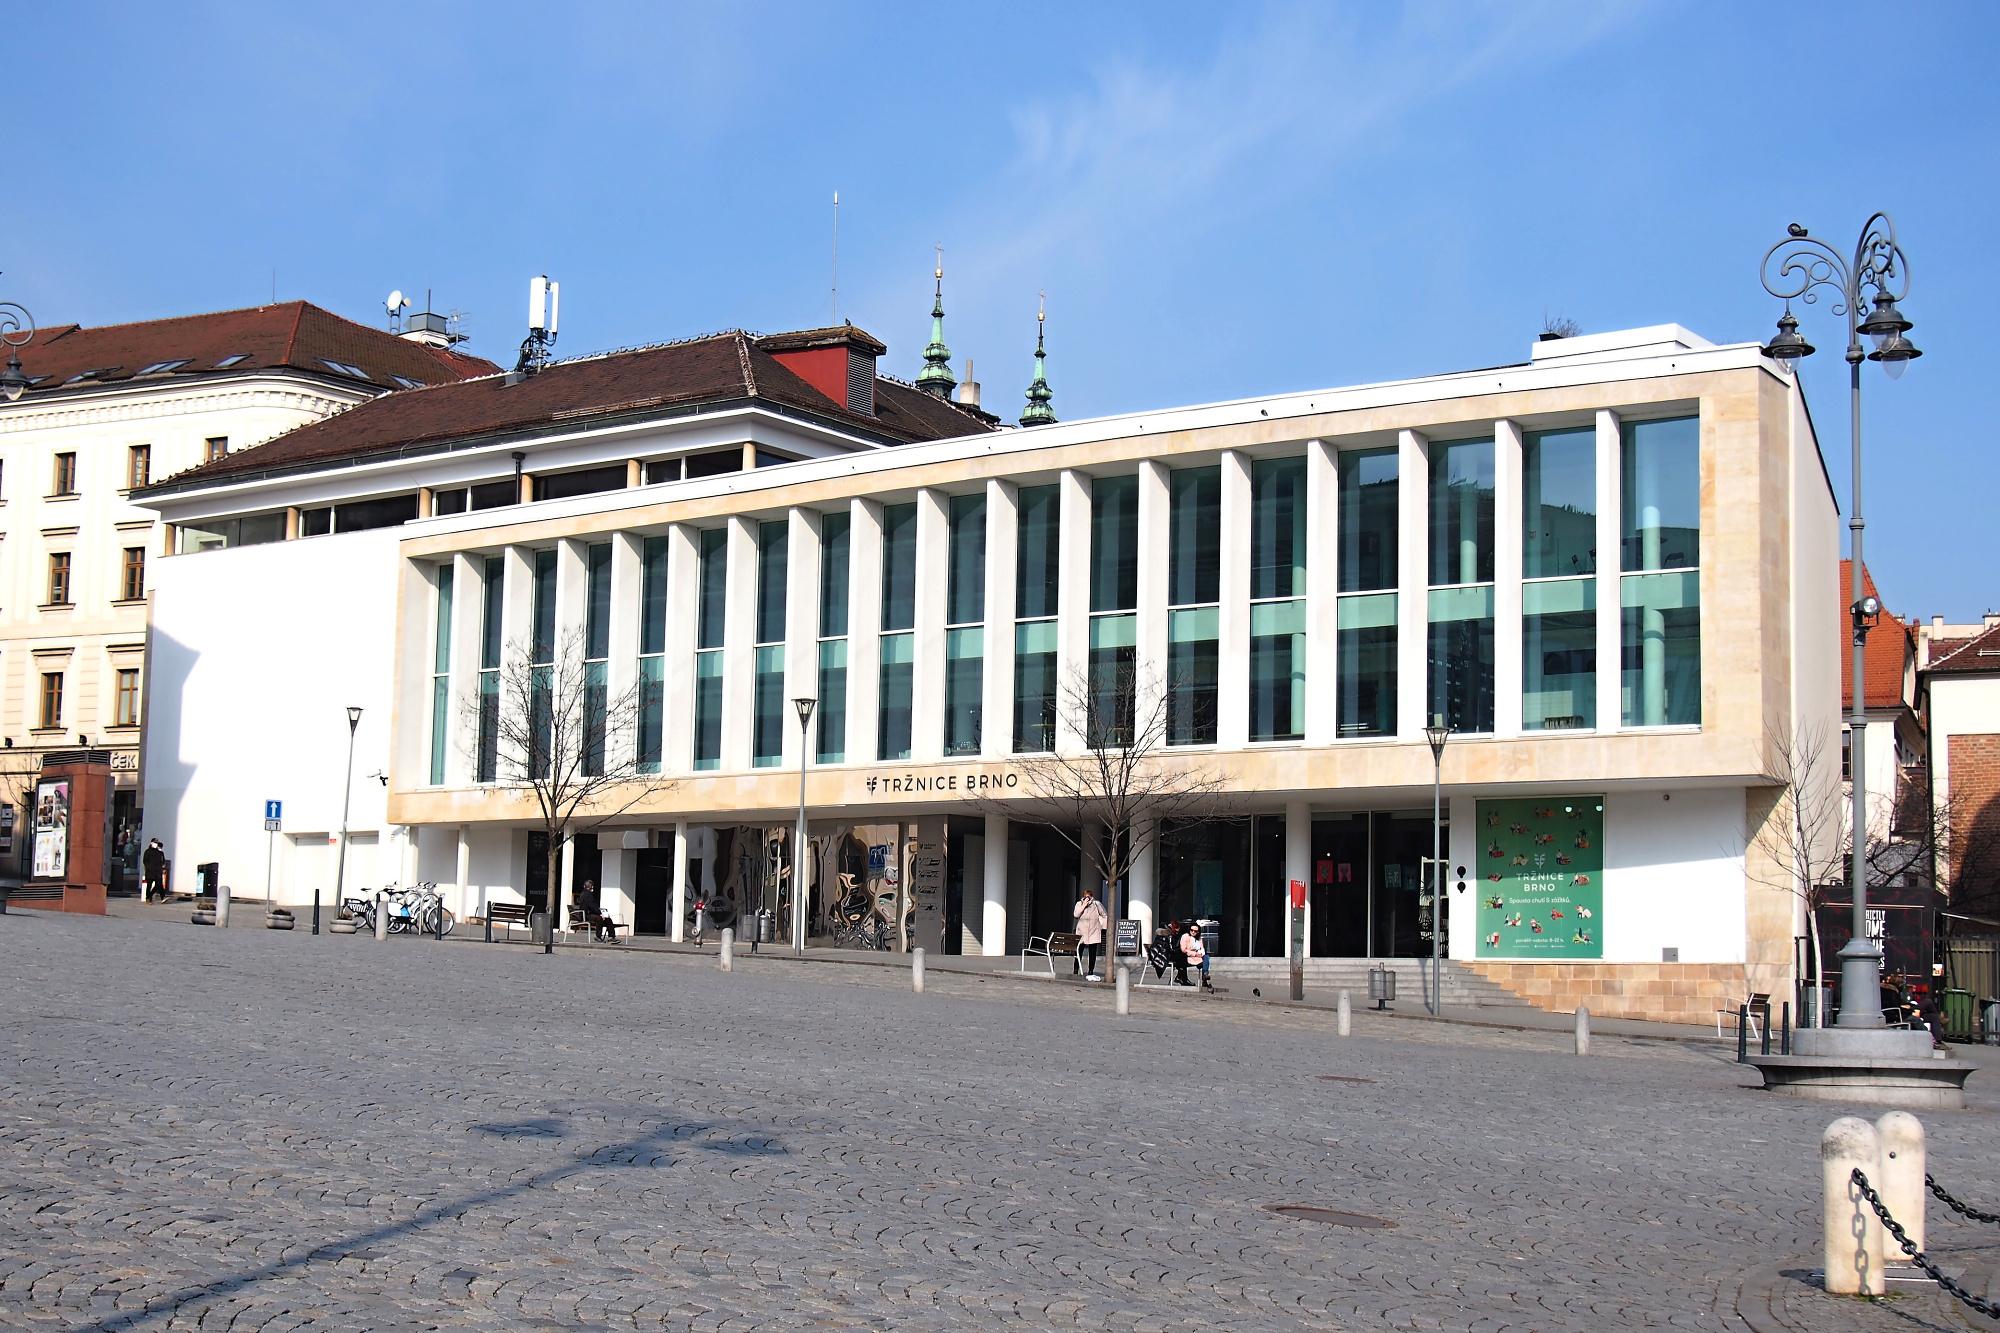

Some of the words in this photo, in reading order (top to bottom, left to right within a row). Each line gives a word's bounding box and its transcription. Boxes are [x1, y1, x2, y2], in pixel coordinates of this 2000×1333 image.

[882, 774, 957, 792] TRŽNICE
[966, 773, 1018, 789] BRNO
[1516, 871, 1564, 881] TRŽNICE
[1523, 883, 1556, 892] BRNO
[1865, 909, 1886, 919] RICTLY
[1865, 919, 1886, 938] OME
